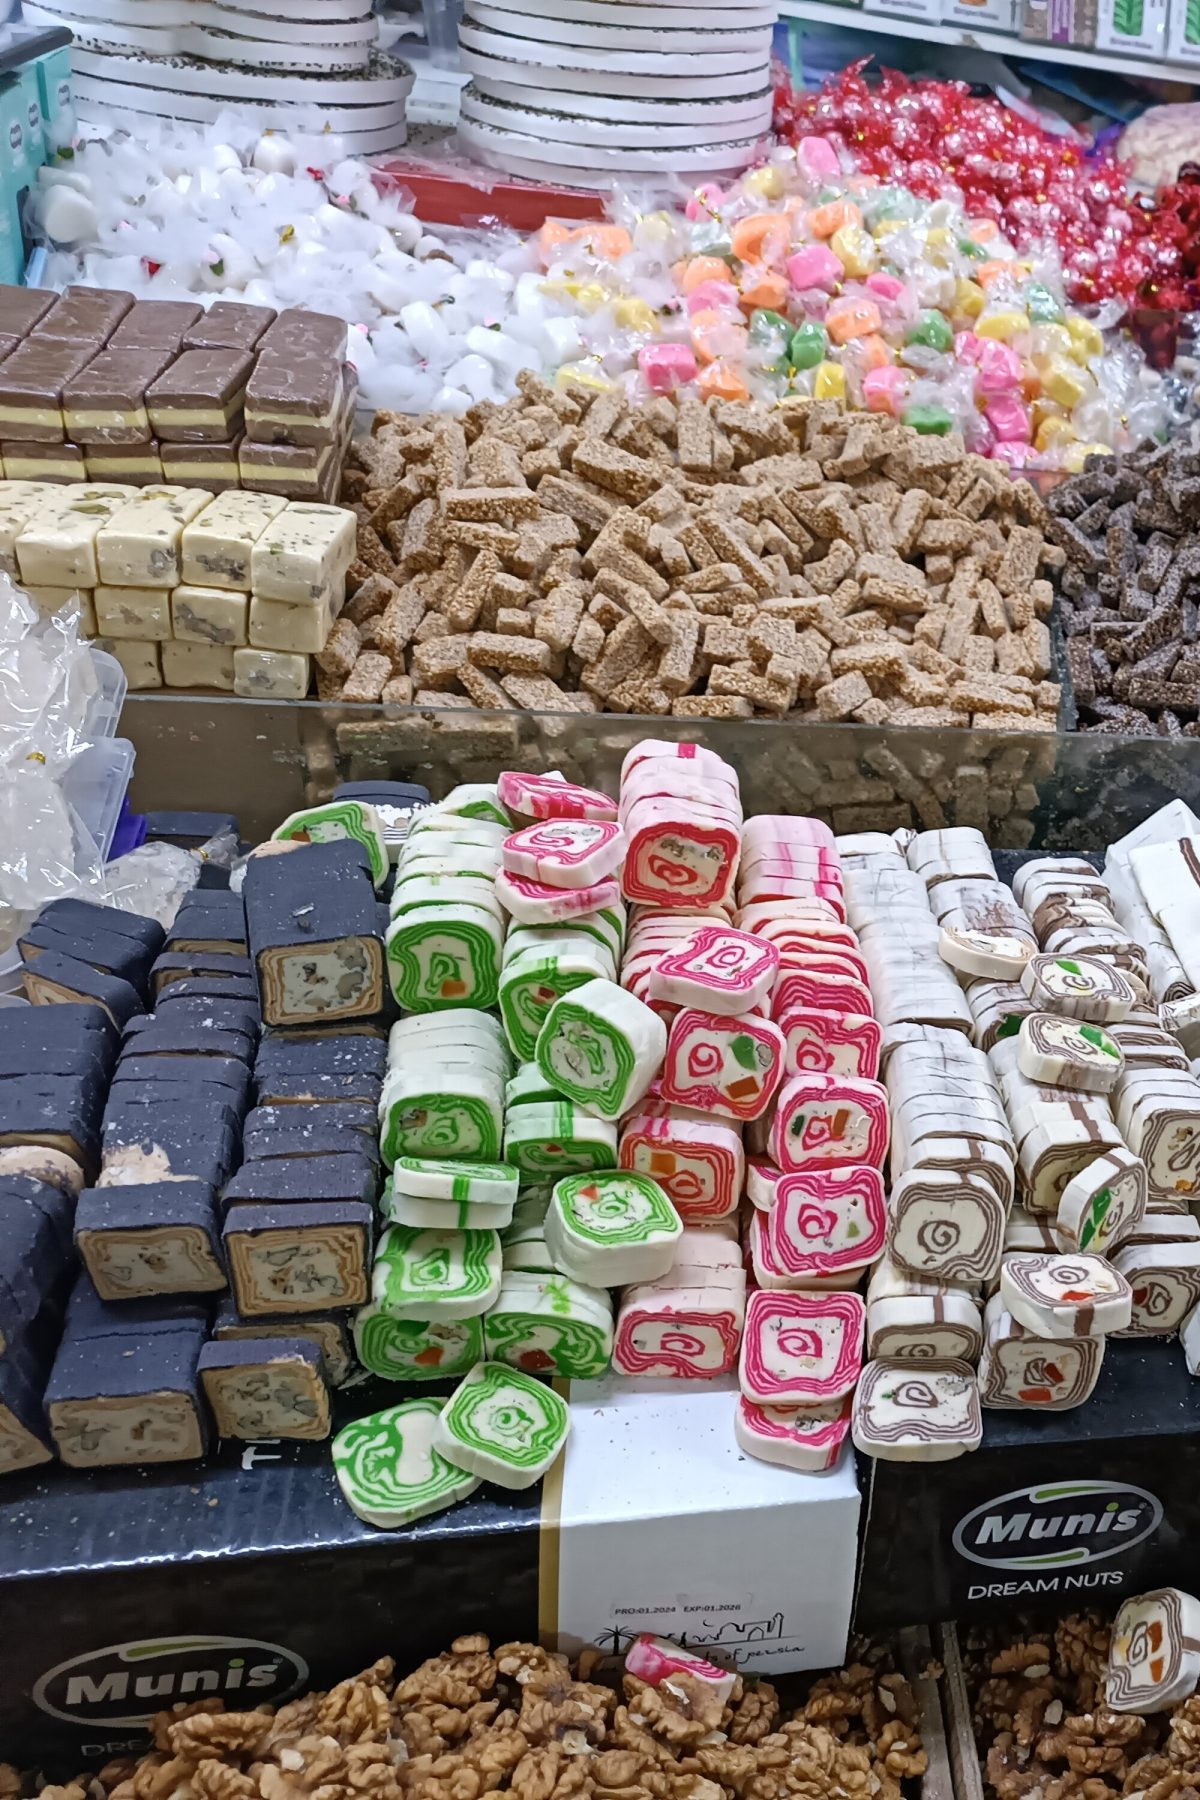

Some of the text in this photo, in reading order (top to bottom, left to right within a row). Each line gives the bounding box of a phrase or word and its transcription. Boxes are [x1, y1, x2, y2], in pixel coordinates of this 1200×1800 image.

[975, 1502, 1143, 1545] Munis
[967, 1570, 1125, 1600] DREAM NUTS
[614, 1605, 677, 1616] PRO:01.2024
[65, 1658, 279, 1705] Munis
[81, 1738, 156, 1757] DRE
